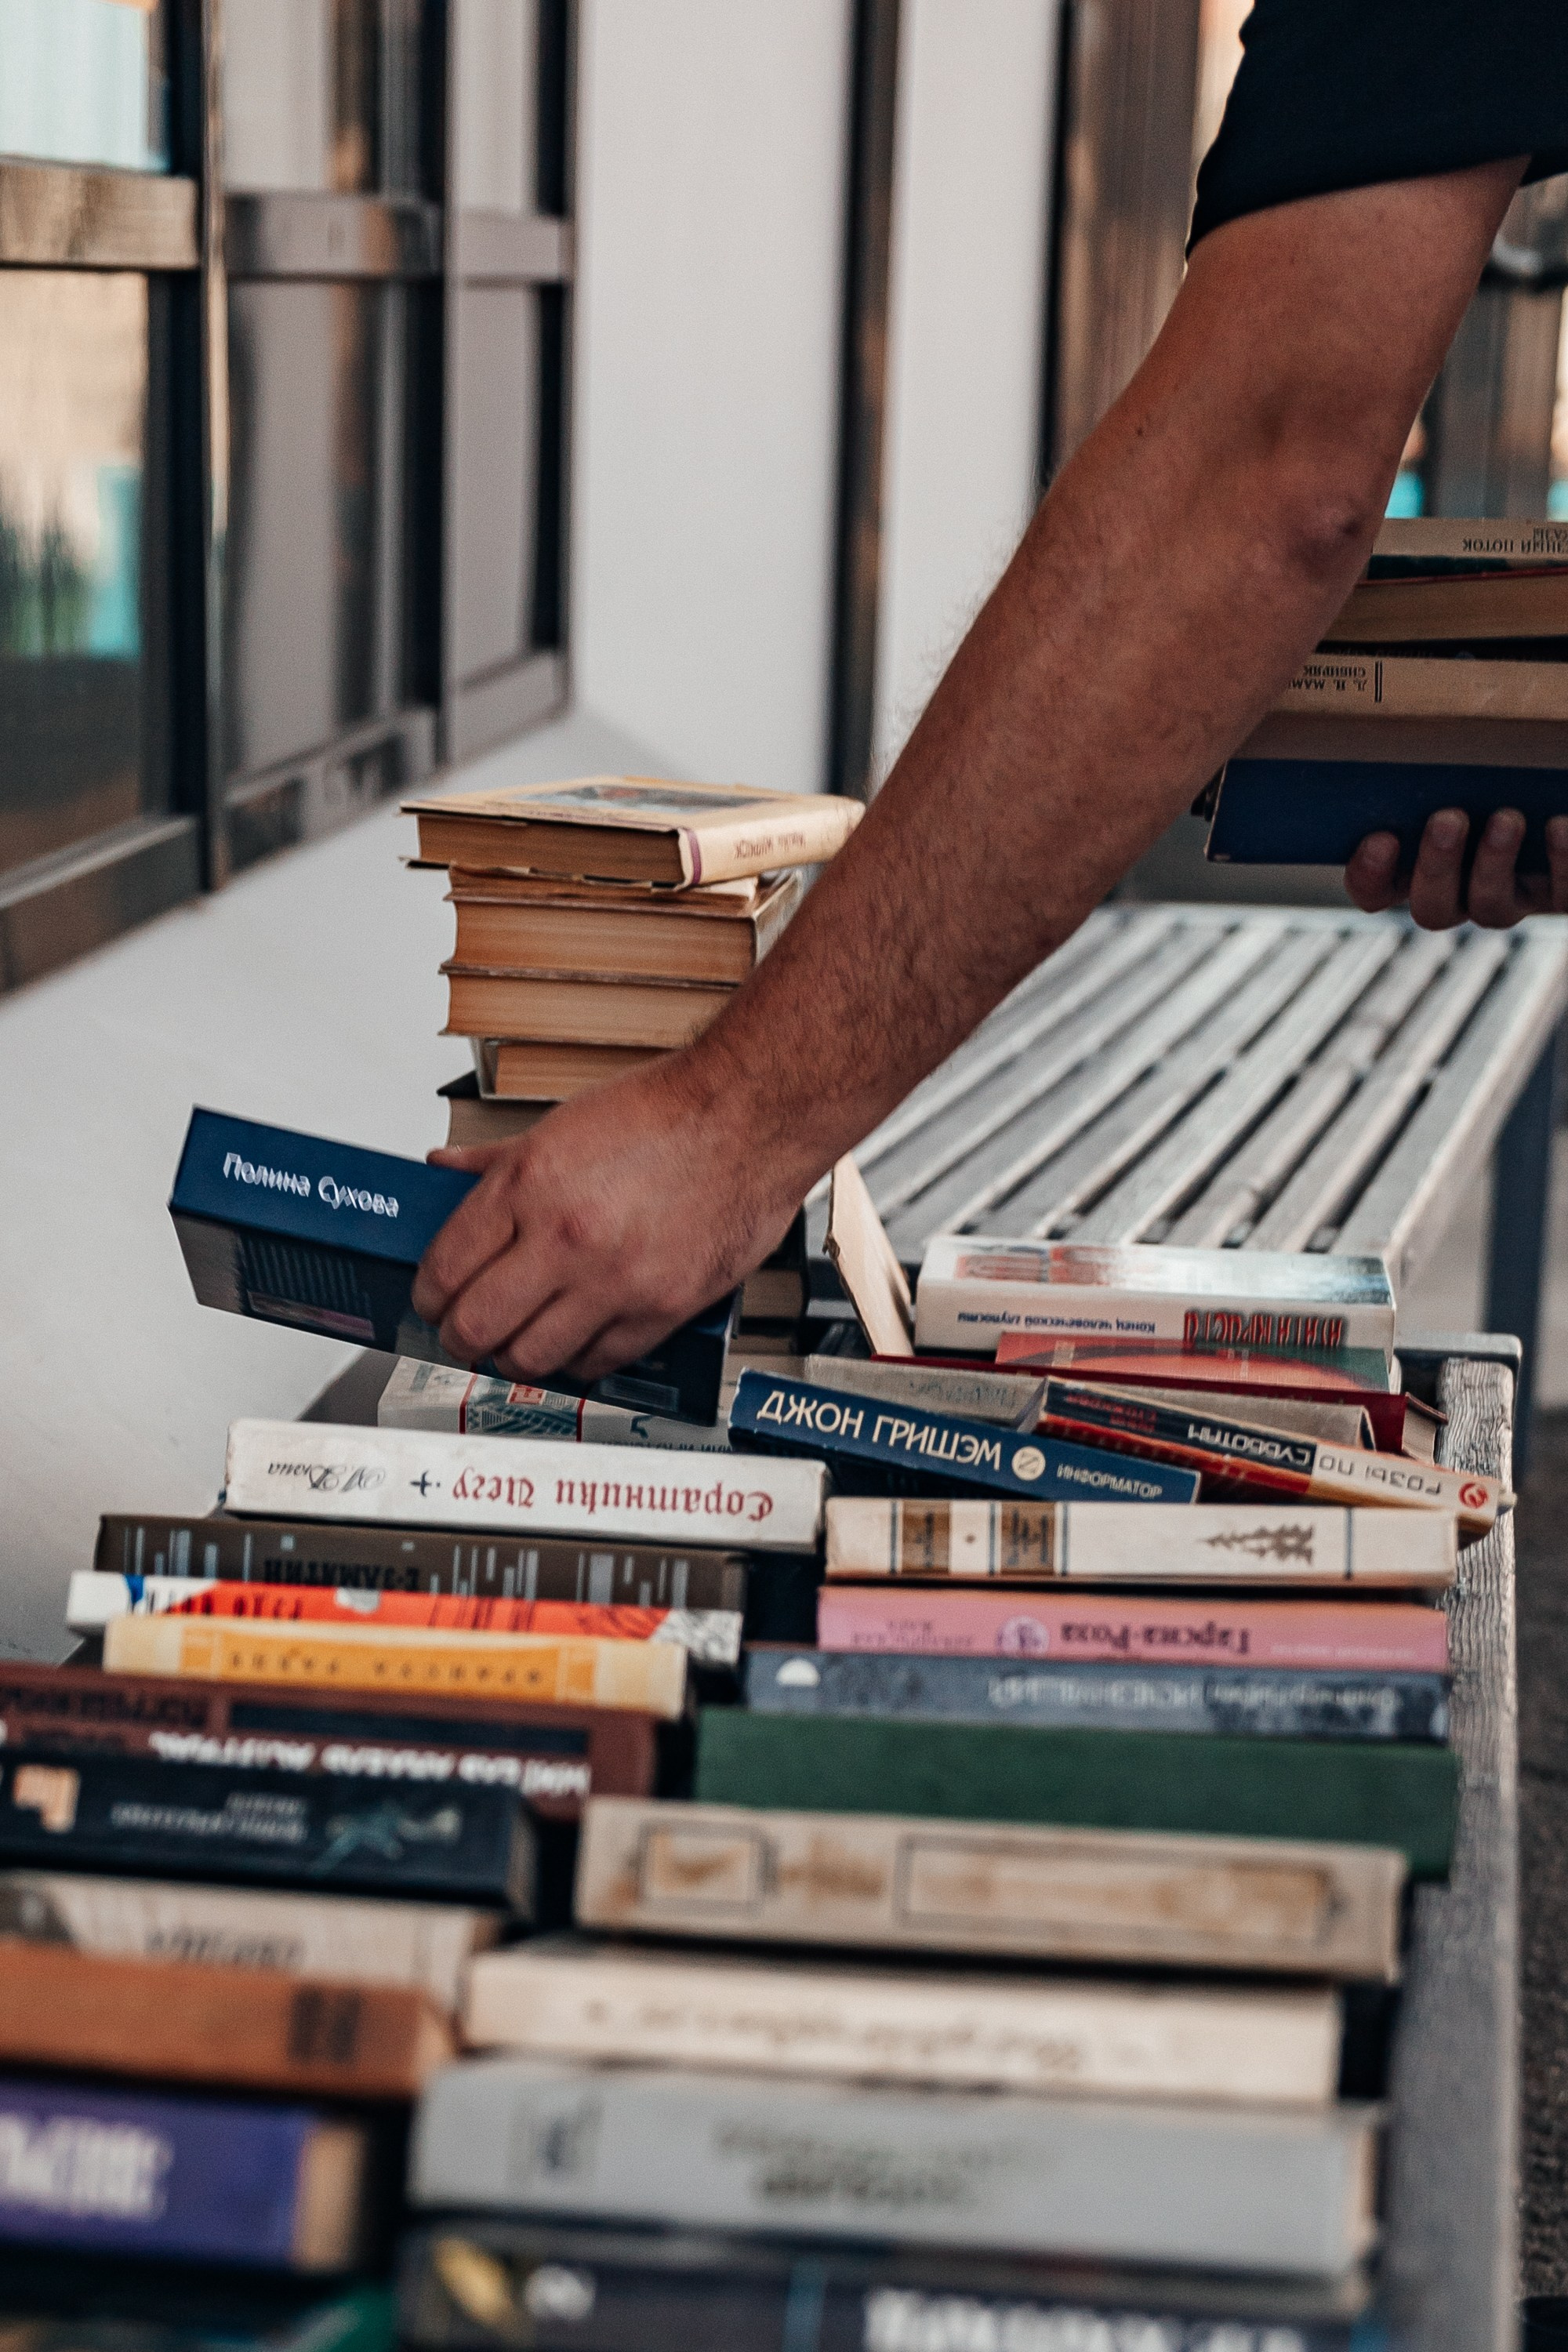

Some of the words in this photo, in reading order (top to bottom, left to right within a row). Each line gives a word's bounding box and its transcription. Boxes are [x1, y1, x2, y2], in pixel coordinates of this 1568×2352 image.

[1461, 537, 1514, 553] ПОТОК
[223, 1152, 311, 1198] Полина
[318, 1176, 400, 1218] Сухова
[957, 1310, 1020, 1327] глупости
[1025, 1315, 1112, 1330] человеческой
[1116, 1317, 1156, 1334] Конец
[756, 1390, 865, 1440] ДЖОН
[872, 1414, 1003, 1472] ГРИШЭМ
[1187, 1422, 1312, 1466] СУББОТАМ
[1056, 1463, 1163, 1499] ИНФОРМАТОР
[1317, 1453, 1356, 1475] ПО
[1364, 1465, 1443, 1497] РОЗЫ
[452, 1466, 535, 1508] Иегу
[556, 1479, 774, 1523] Соратники
